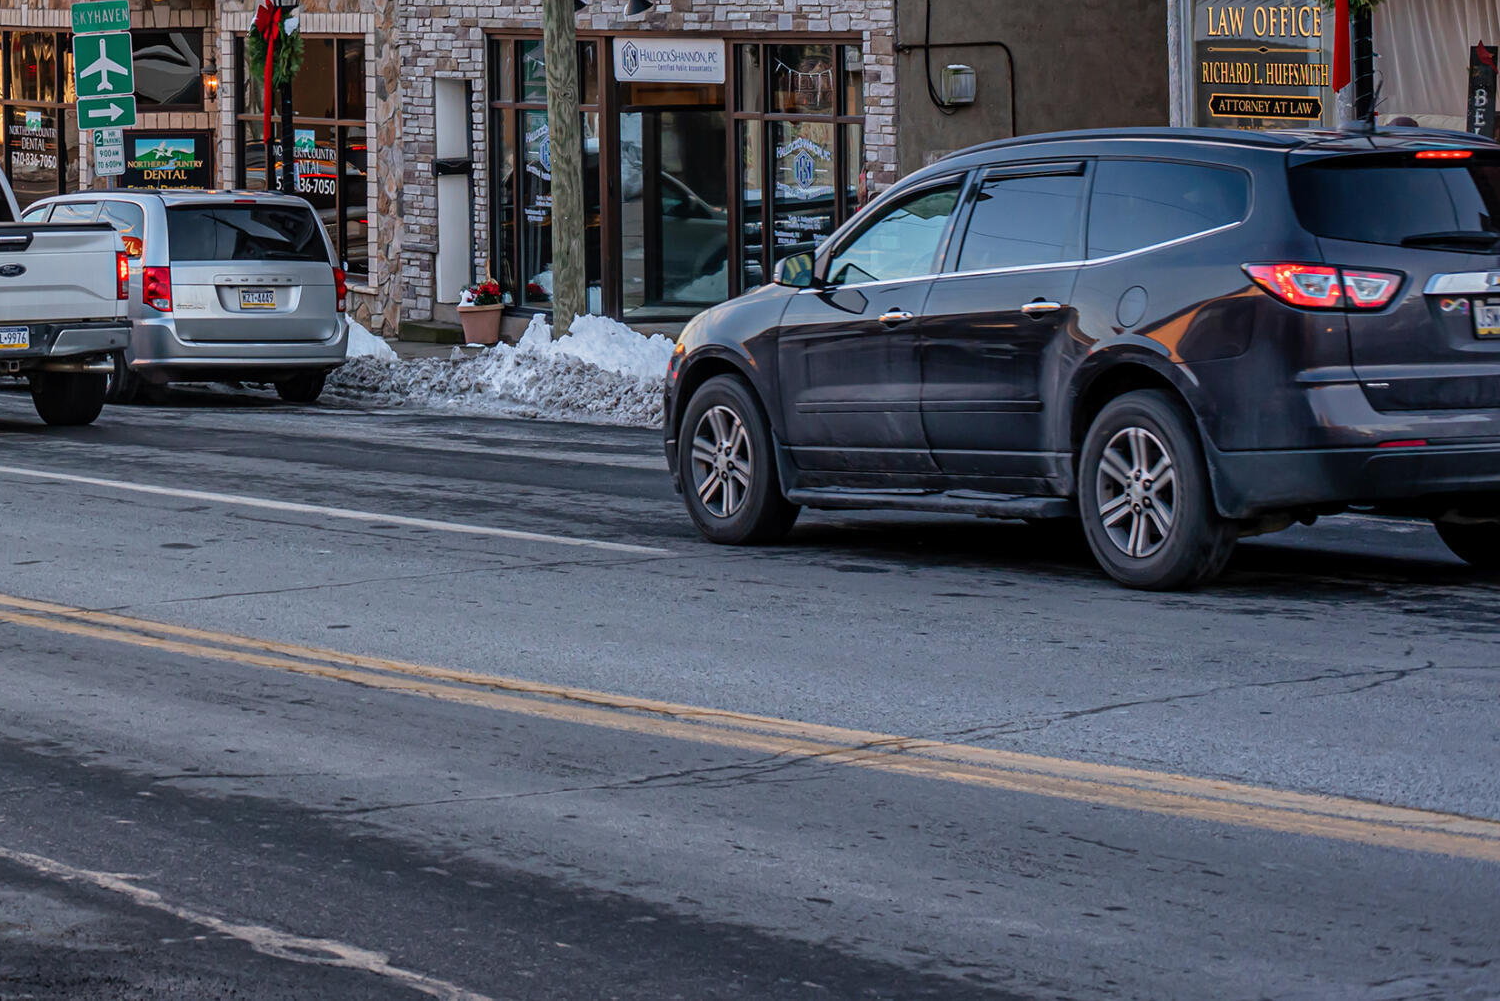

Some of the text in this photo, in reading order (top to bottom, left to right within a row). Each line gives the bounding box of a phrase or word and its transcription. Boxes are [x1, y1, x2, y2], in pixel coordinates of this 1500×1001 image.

[73, 7, 129, 26] SKYHAVEN
[1207, 6, 1323, 38] LAW OFFICE
[707, 51, 718, 63] PC
[657, 63, 675, 71] Certified
[1202, 61, 1330, 87] RICHARD L. HUFFSMITH
[1218, 99, 1313, 115] ATTORNEY AT LAW
[21, 137, 46, 151] DENTAL
[95, 133, 103, 145] 2
[99, 149, 112, 158] 9:00
[127, 160, 204, 169] NORTHERN COUNTRY
[143, 169, 188, 180] DENTAL
